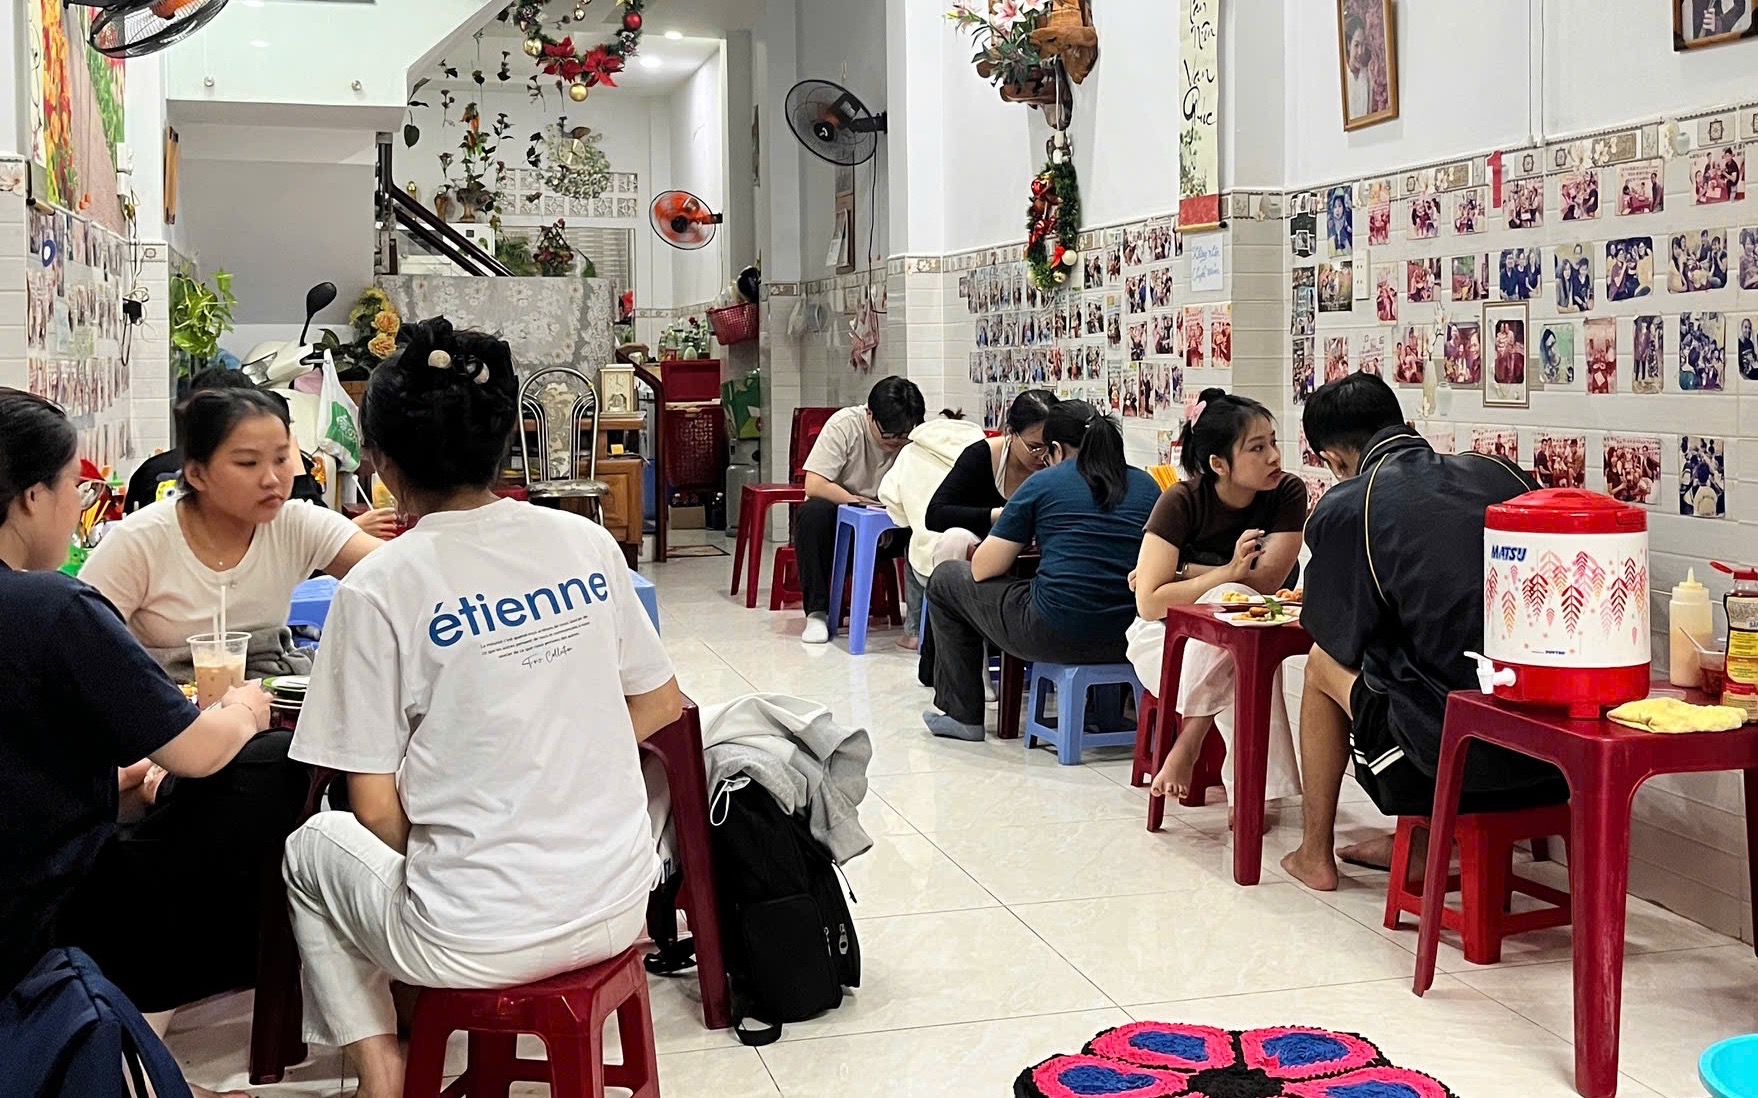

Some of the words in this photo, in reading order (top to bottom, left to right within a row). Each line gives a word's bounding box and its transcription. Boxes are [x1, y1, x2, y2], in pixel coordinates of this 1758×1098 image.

[1487, 150, 1502, 209] 1
[1491, 545, 1527, 562] MATSU
[428, 572, 608, 648] étienne
